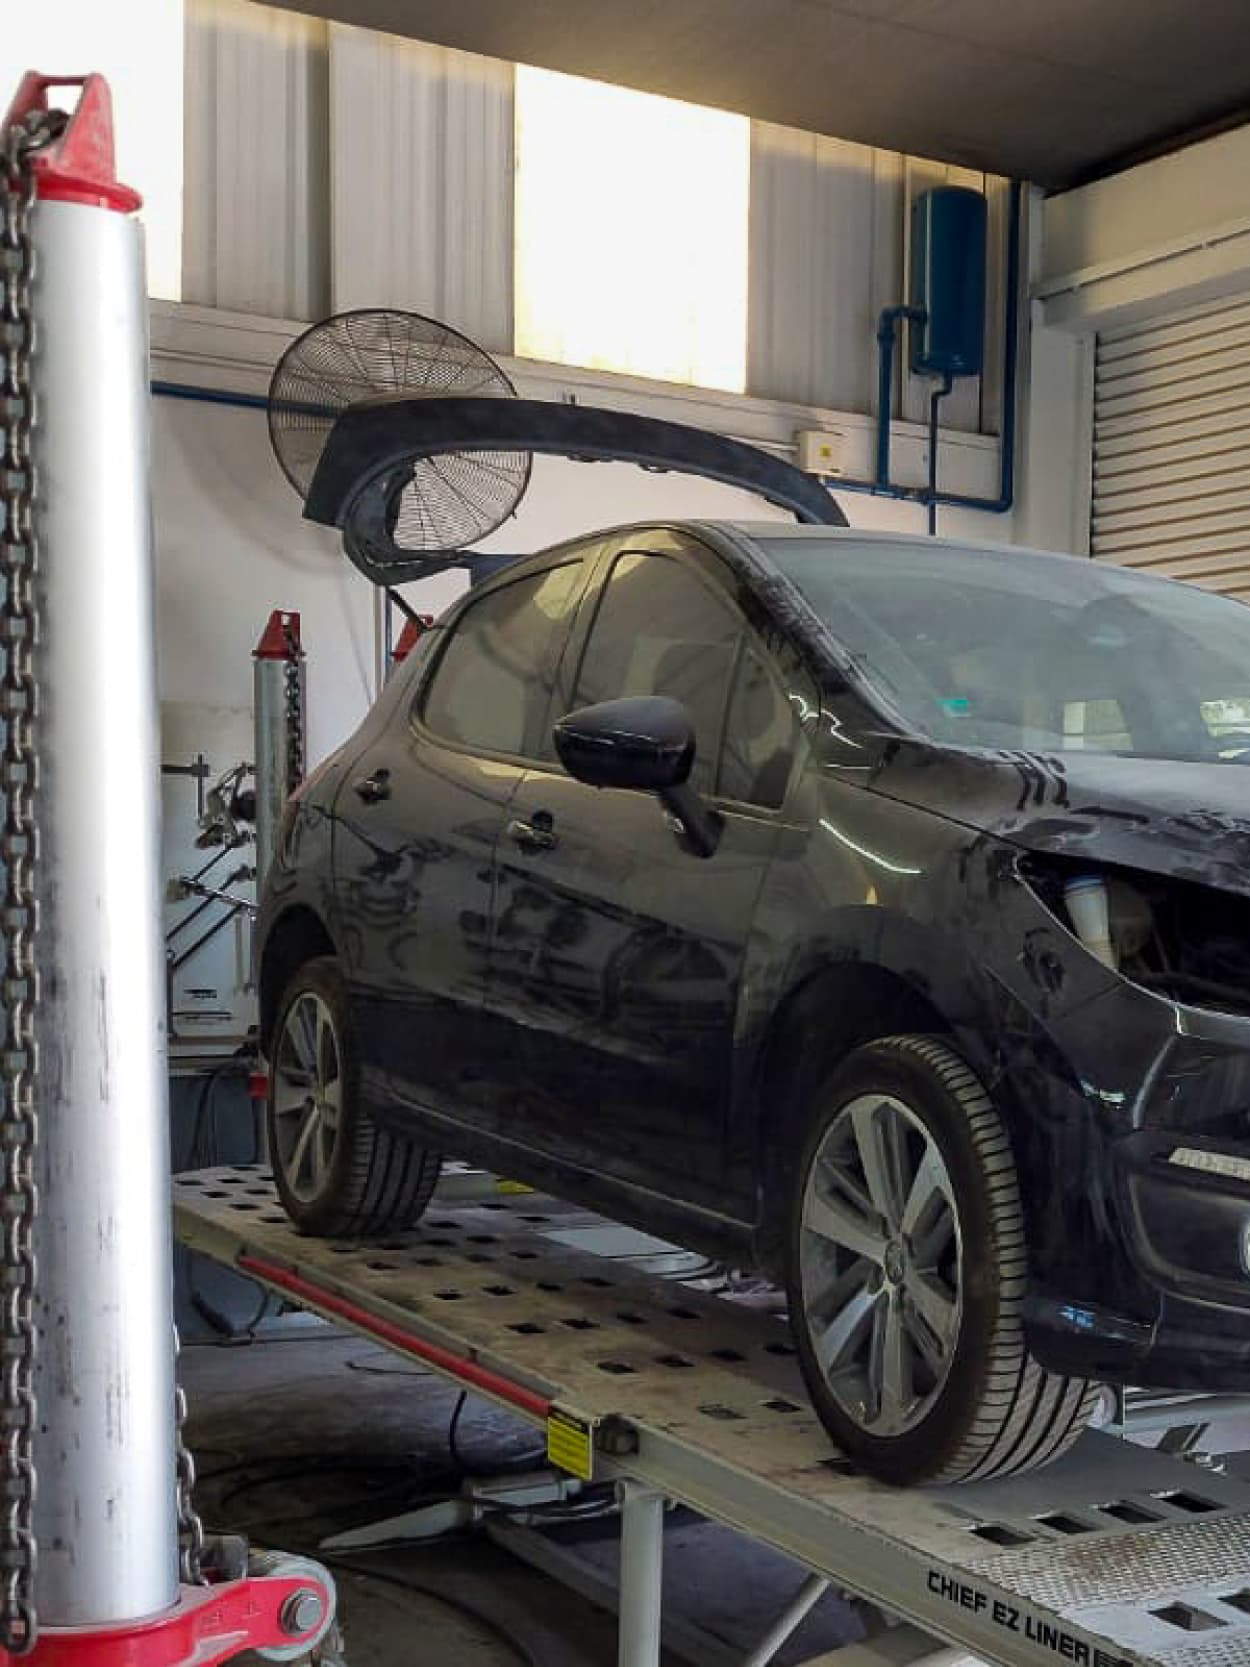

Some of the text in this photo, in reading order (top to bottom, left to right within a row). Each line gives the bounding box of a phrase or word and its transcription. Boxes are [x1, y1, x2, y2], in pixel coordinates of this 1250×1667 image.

[927, 1570, 987, 1613] CHIEF
[992, 1601, 1020, 1631] EZ
[1025, 1616, 1089, 1667] LINER
